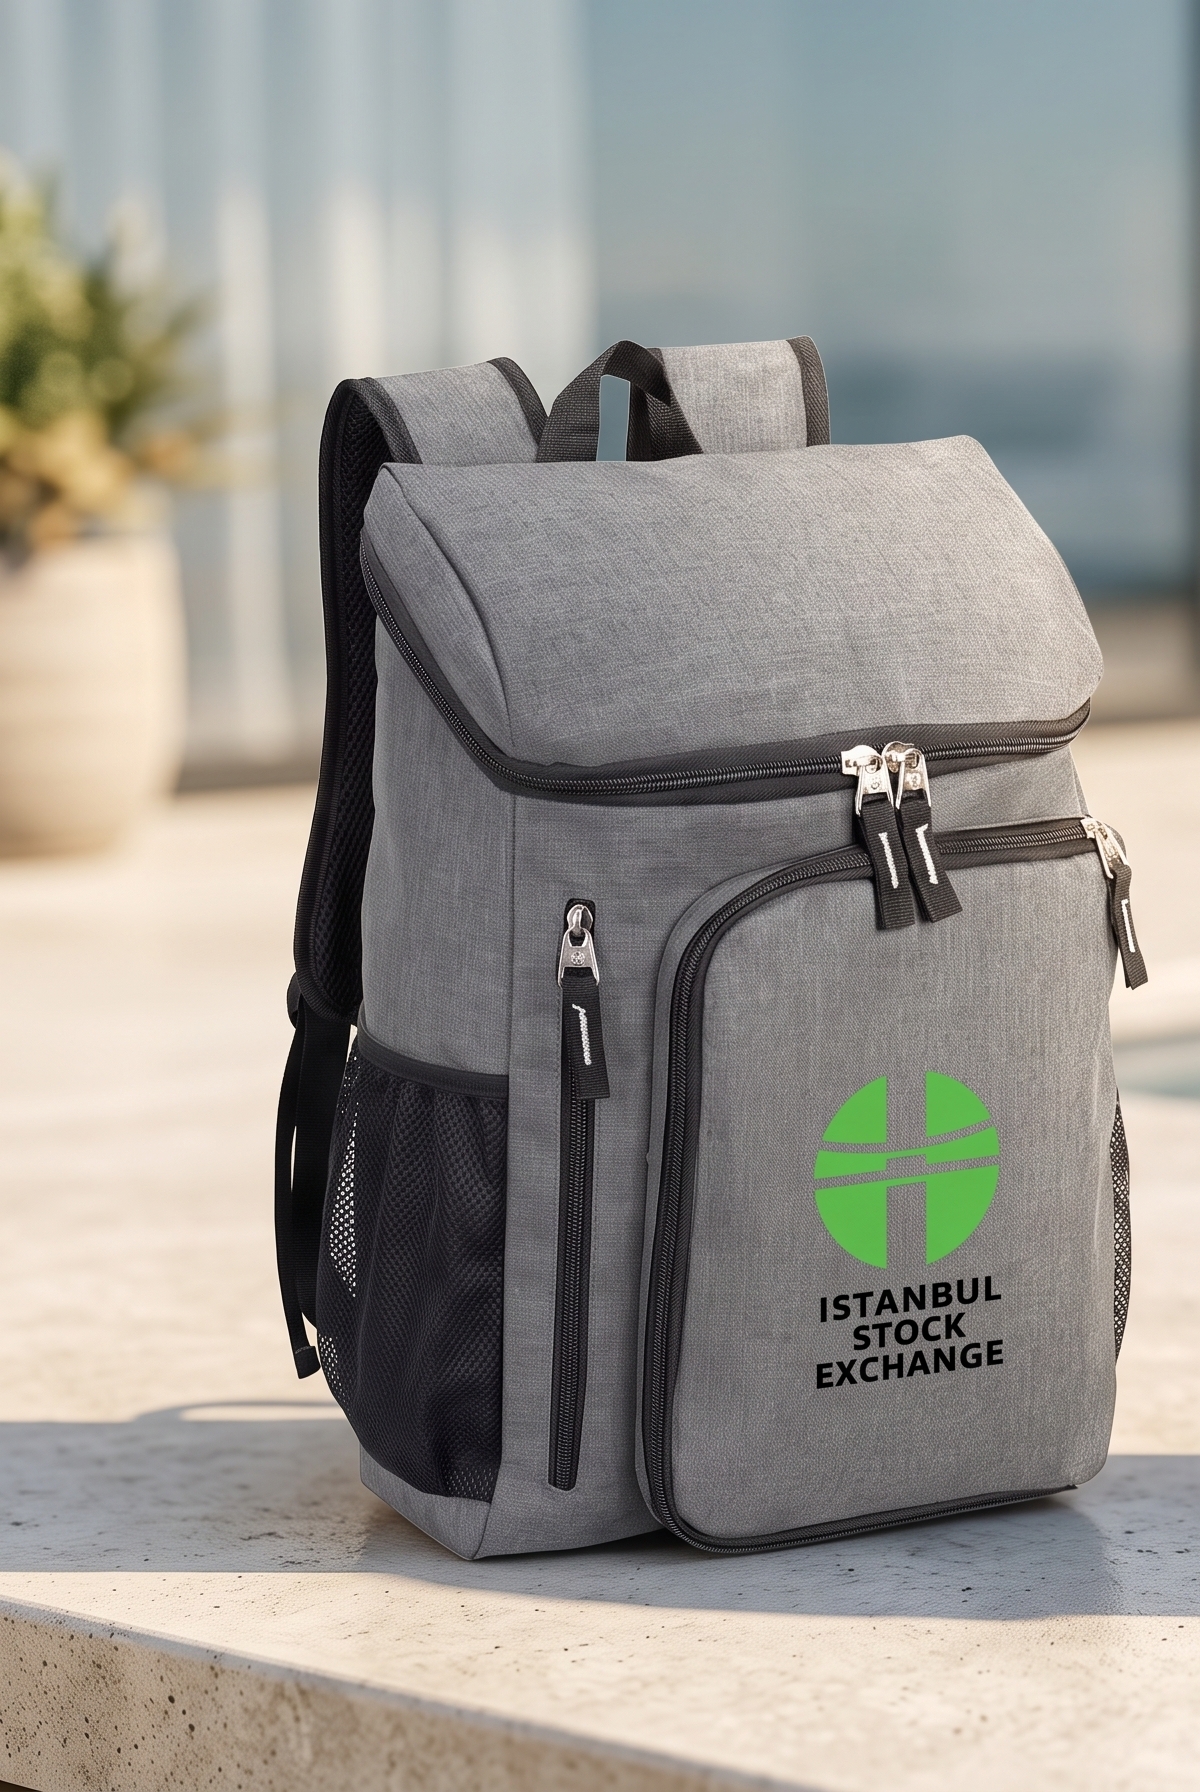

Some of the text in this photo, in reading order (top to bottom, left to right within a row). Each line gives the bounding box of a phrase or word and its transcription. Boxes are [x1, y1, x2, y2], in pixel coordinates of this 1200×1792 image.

[820, 1275, 1002, 1323] ISTANBUL
[853, 1312, 966, 1351] STOCK
[816, 1340, 1004, 1389] EXCHANGE
